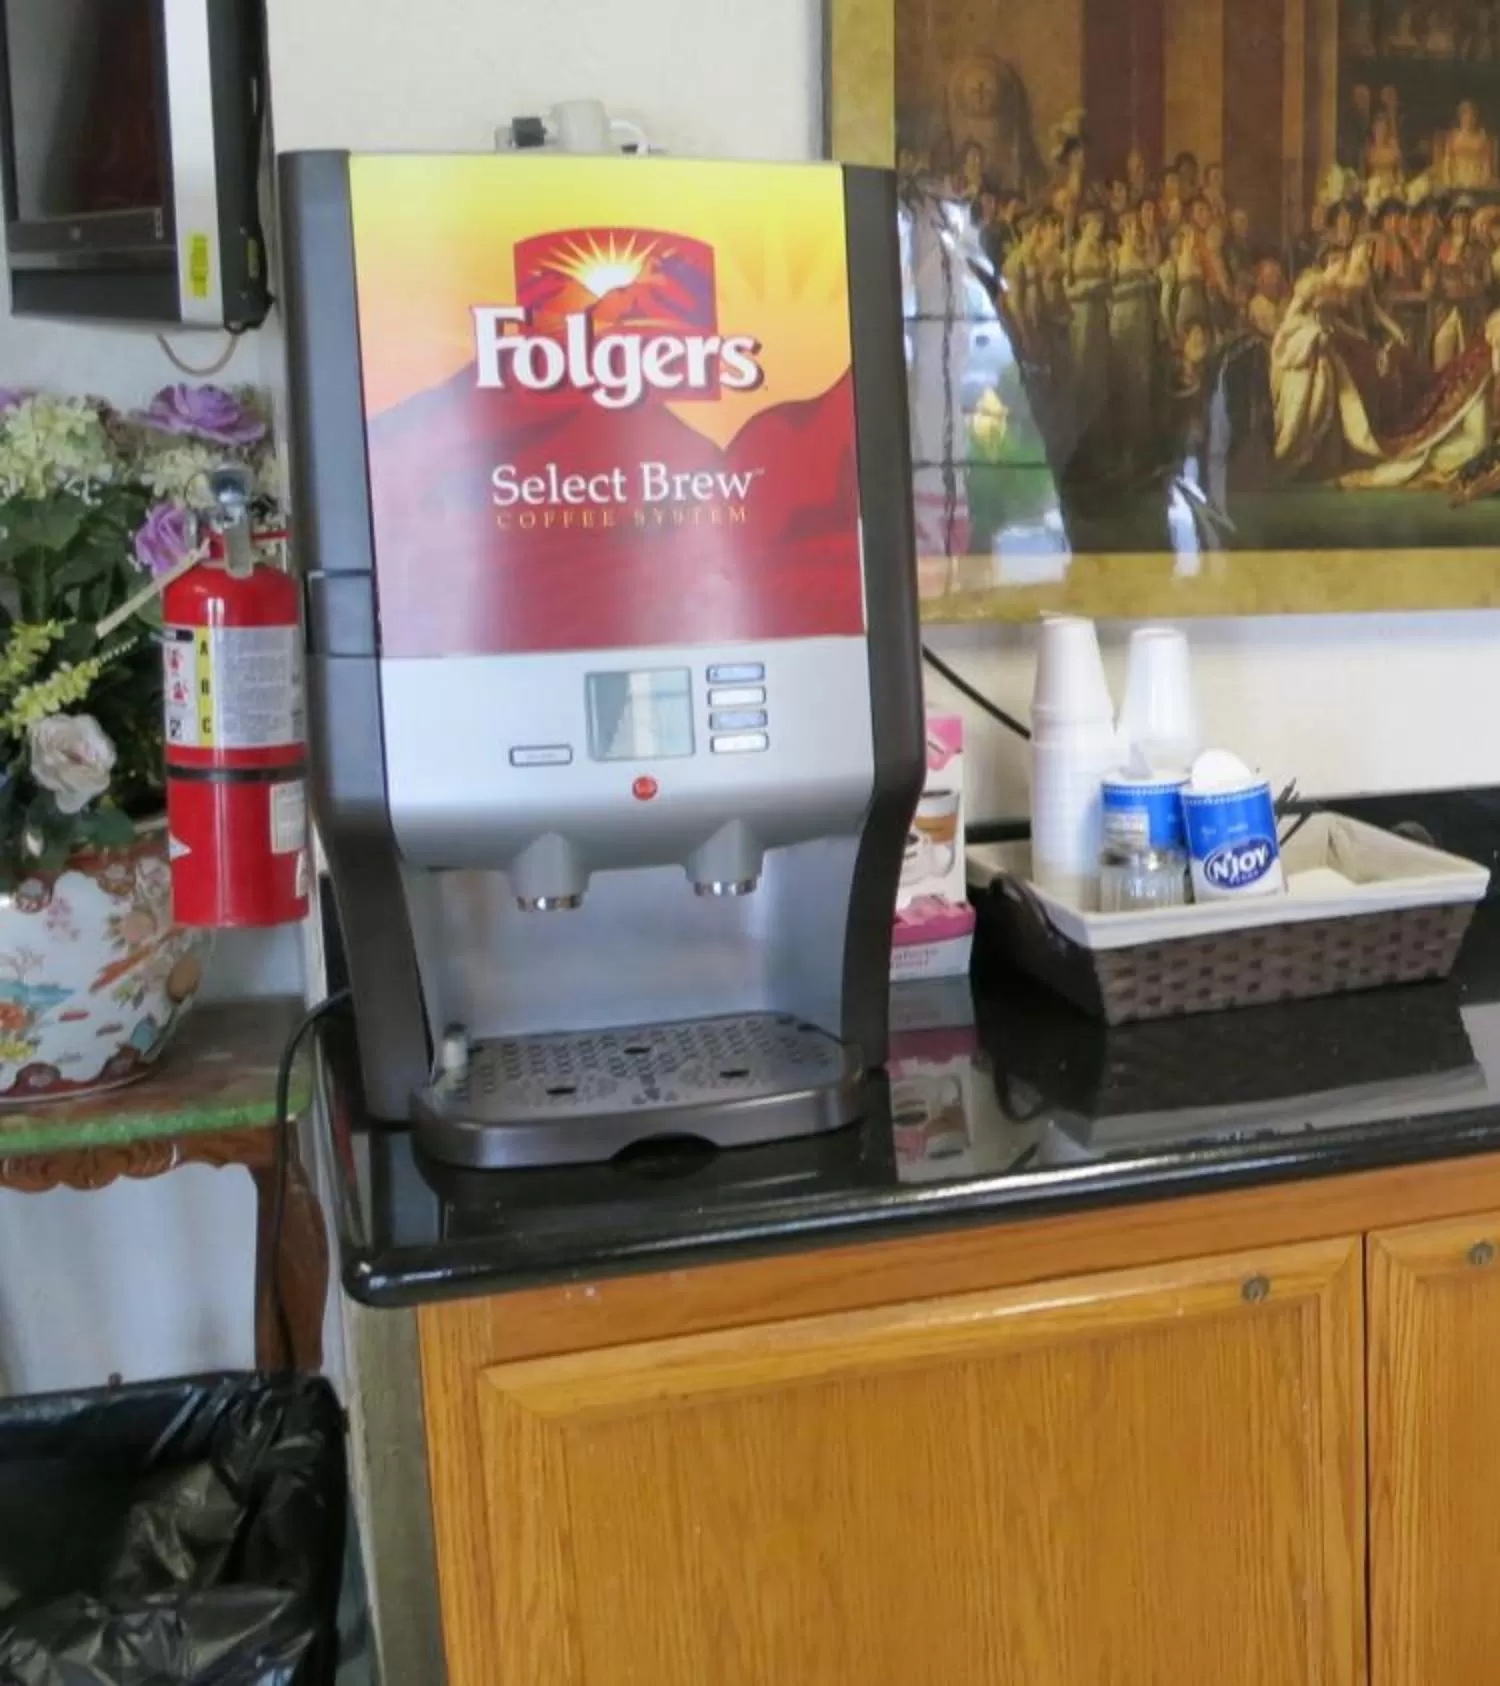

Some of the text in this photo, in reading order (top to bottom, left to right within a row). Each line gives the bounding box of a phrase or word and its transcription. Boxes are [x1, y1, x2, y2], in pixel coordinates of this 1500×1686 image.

[471, 305, 764, 408] Folgers
[491, 463, 627, 506] Select
[496, 506, 747, 529] COFFEE SYSTEM
[199, 640, 209, 656] A
[201, 716, 212, 734] C
